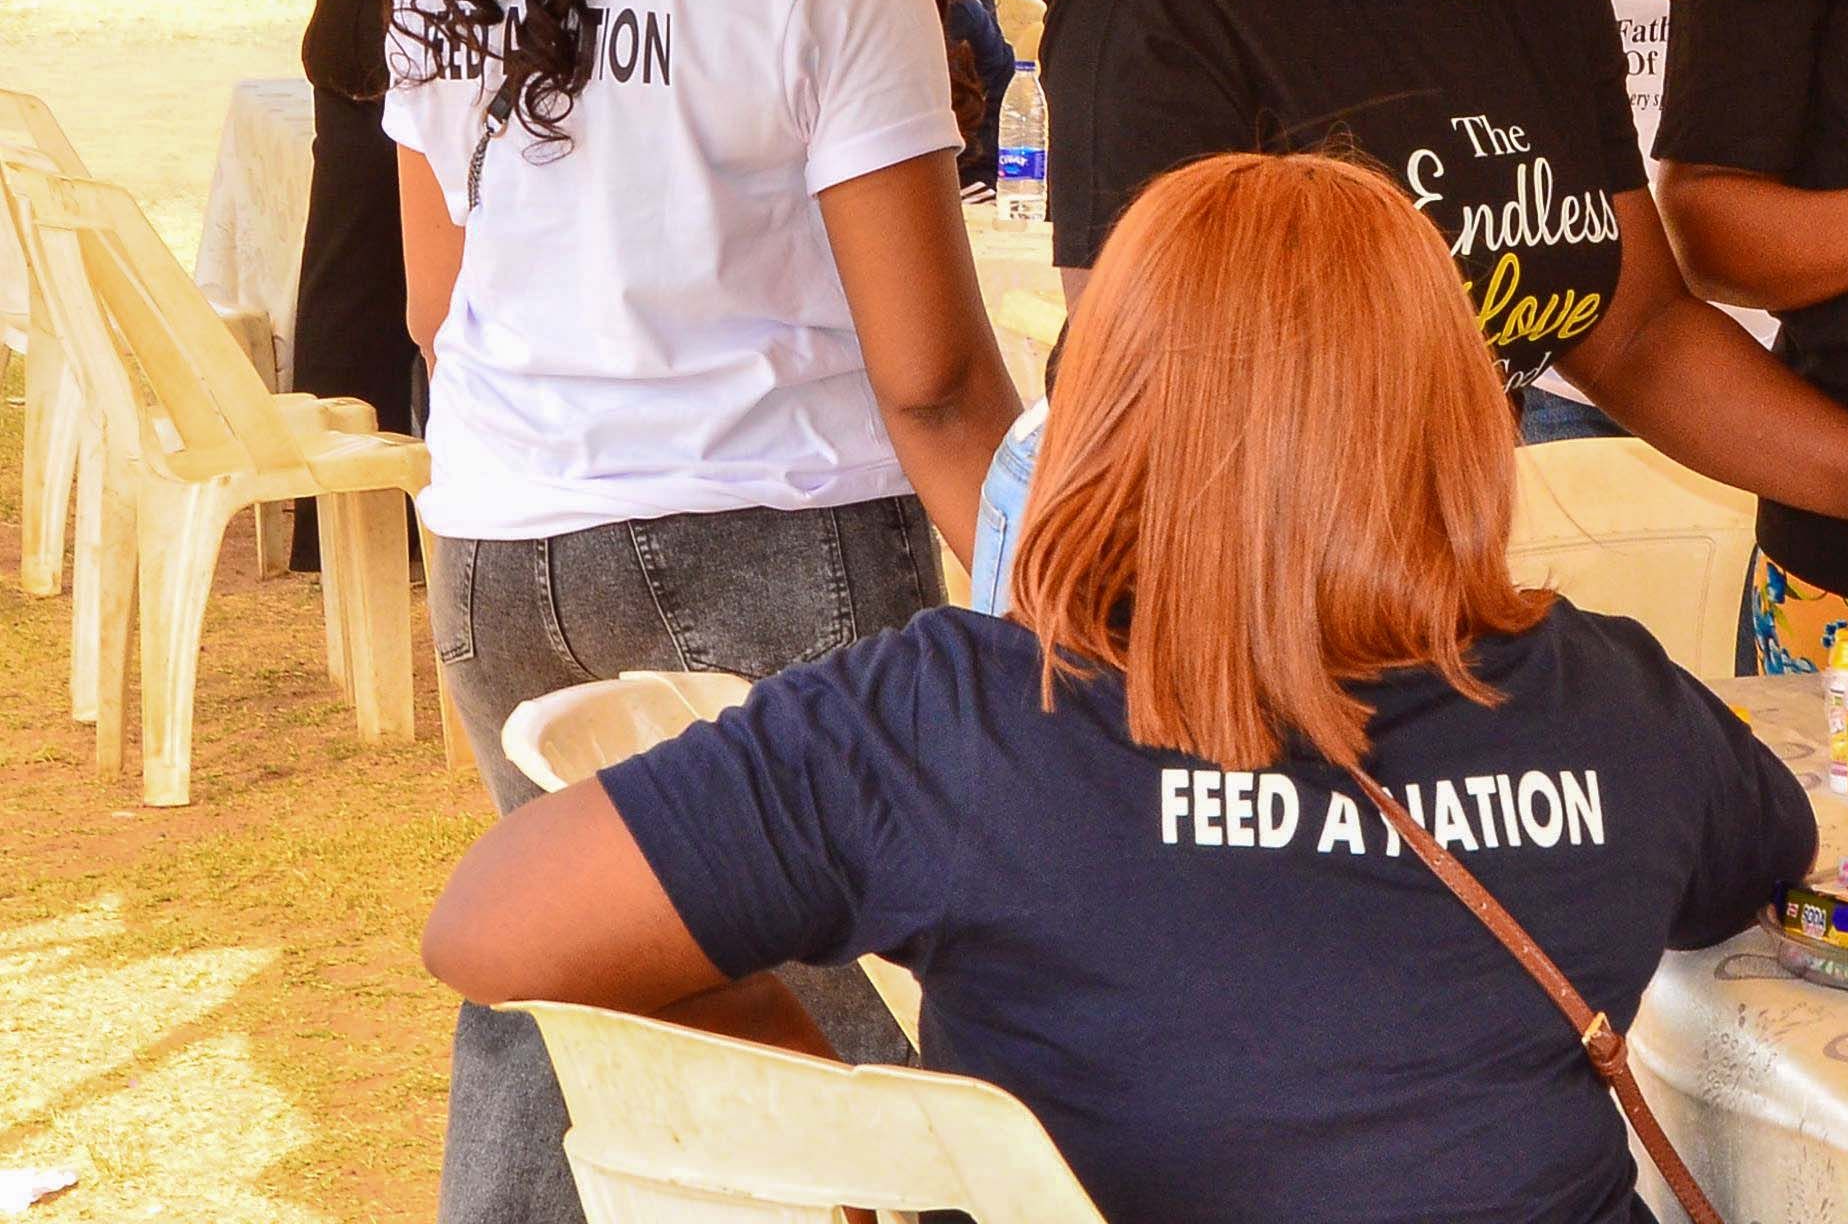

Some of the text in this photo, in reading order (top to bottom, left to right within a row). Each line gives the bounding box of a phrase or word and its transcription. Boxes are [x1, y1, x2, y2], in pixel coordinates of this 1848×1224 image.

[1450, 115, 1532, 158] The
[1406, 149, 1620, 257] Endless
[1161, 768, 1300, 848] FEED
[1317, 790, 1366, 855] A
[1803, 906, 1826, 927] SODA
